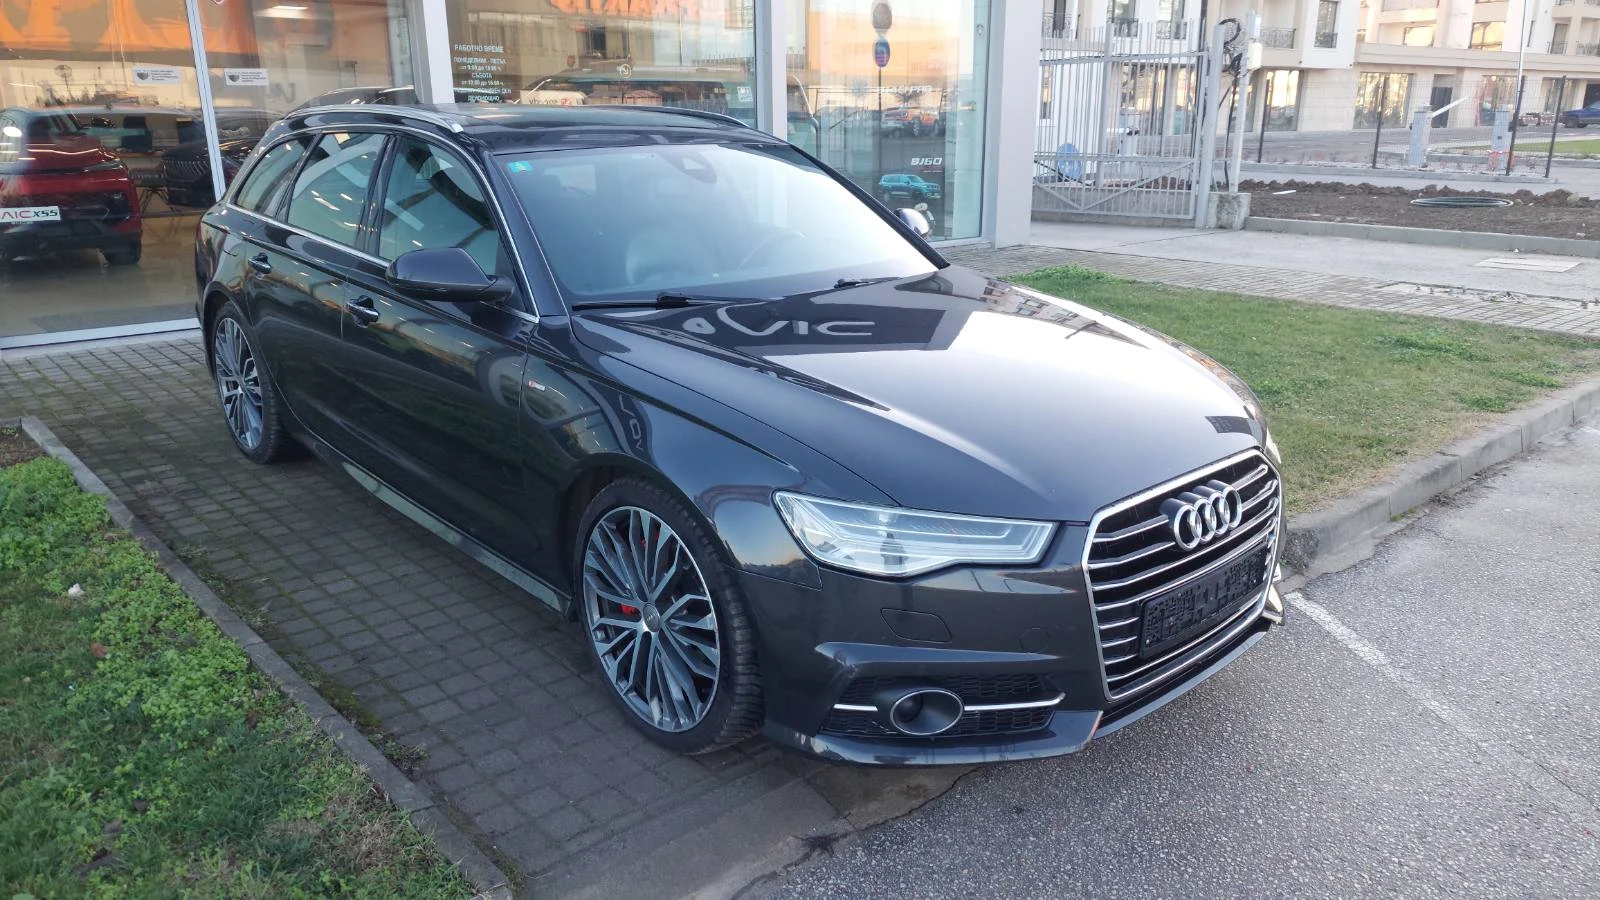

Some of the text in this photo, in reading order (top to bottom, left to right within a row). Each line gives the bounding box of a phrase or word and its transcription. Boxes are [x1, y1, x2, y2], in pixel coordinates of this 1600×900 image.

[454, 44, 483, 52] РАБОТНО
[911, 157, 943, 166] BJ60
[0, 210, 32, 220] AIC
